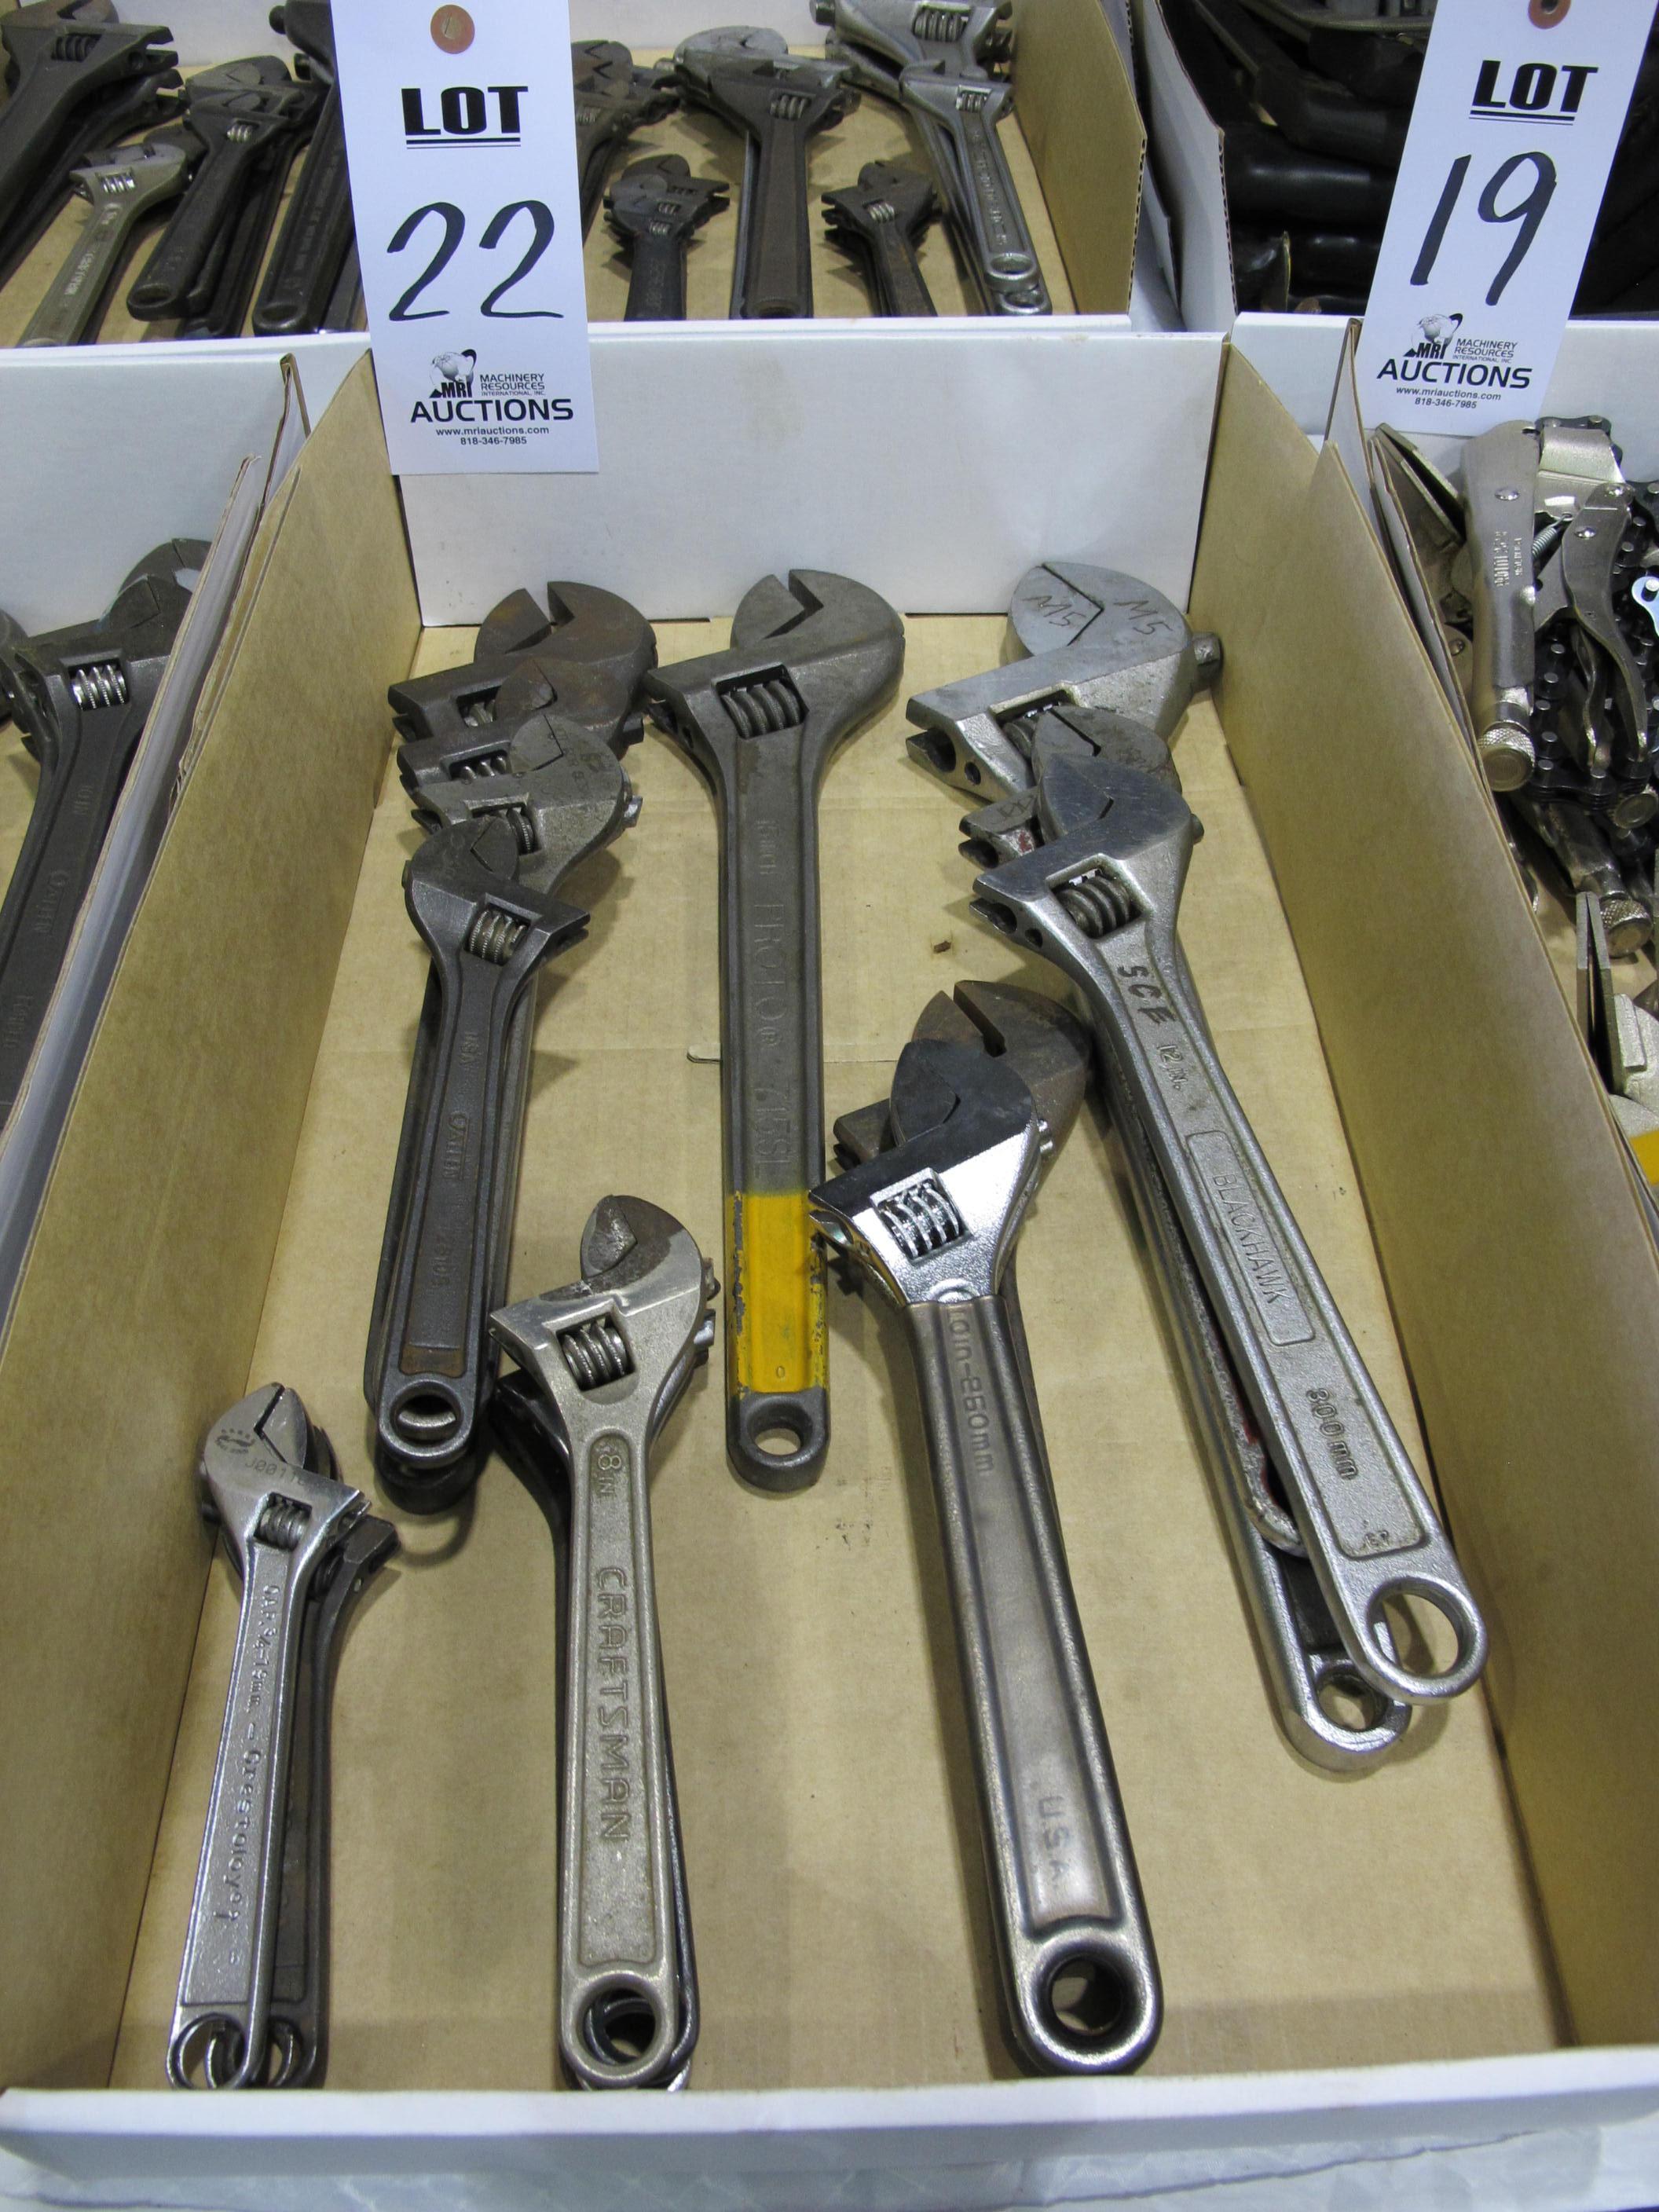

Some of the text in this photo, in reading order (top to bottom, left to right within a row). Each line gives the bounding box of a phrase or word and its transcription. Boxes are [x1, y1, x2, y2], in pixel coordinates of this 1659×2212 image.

[1471, 60, 1599, 112] LOT
[401, 86, 528, 136] LOT
[1409, 151, 1558, 306] 19
[386, 200, 565, 321] 22
[1415, 342, 1448, 360] MRI
[1454, 346, 1514, 358] RESOURCES
[1456, 338, 1518, 350] MACHINERY
[480, 373, 544, 383] MACHINERY
[1376, 358, 1533, 389] AUCTIONS
[441, 382, 473, 398] MRI
[481, 382, 545, 391] RESOURCES
[1396, 386, 1502, 401] www.mriauctions.com
[410, 398, 573, 423] AUCTIONS
[1415, 397, 1478, 408] 818-346-7985
[436, 426, 549, 436] www.mriauctions.com
[460, 436, 527, 445] 818-346-7985
[1213, 1173, 1292, 1304] BLACKHAWK
[598, 1453, 622, 1470] 8
[595, 1566, 631, 1841] CRAFTSMAN
